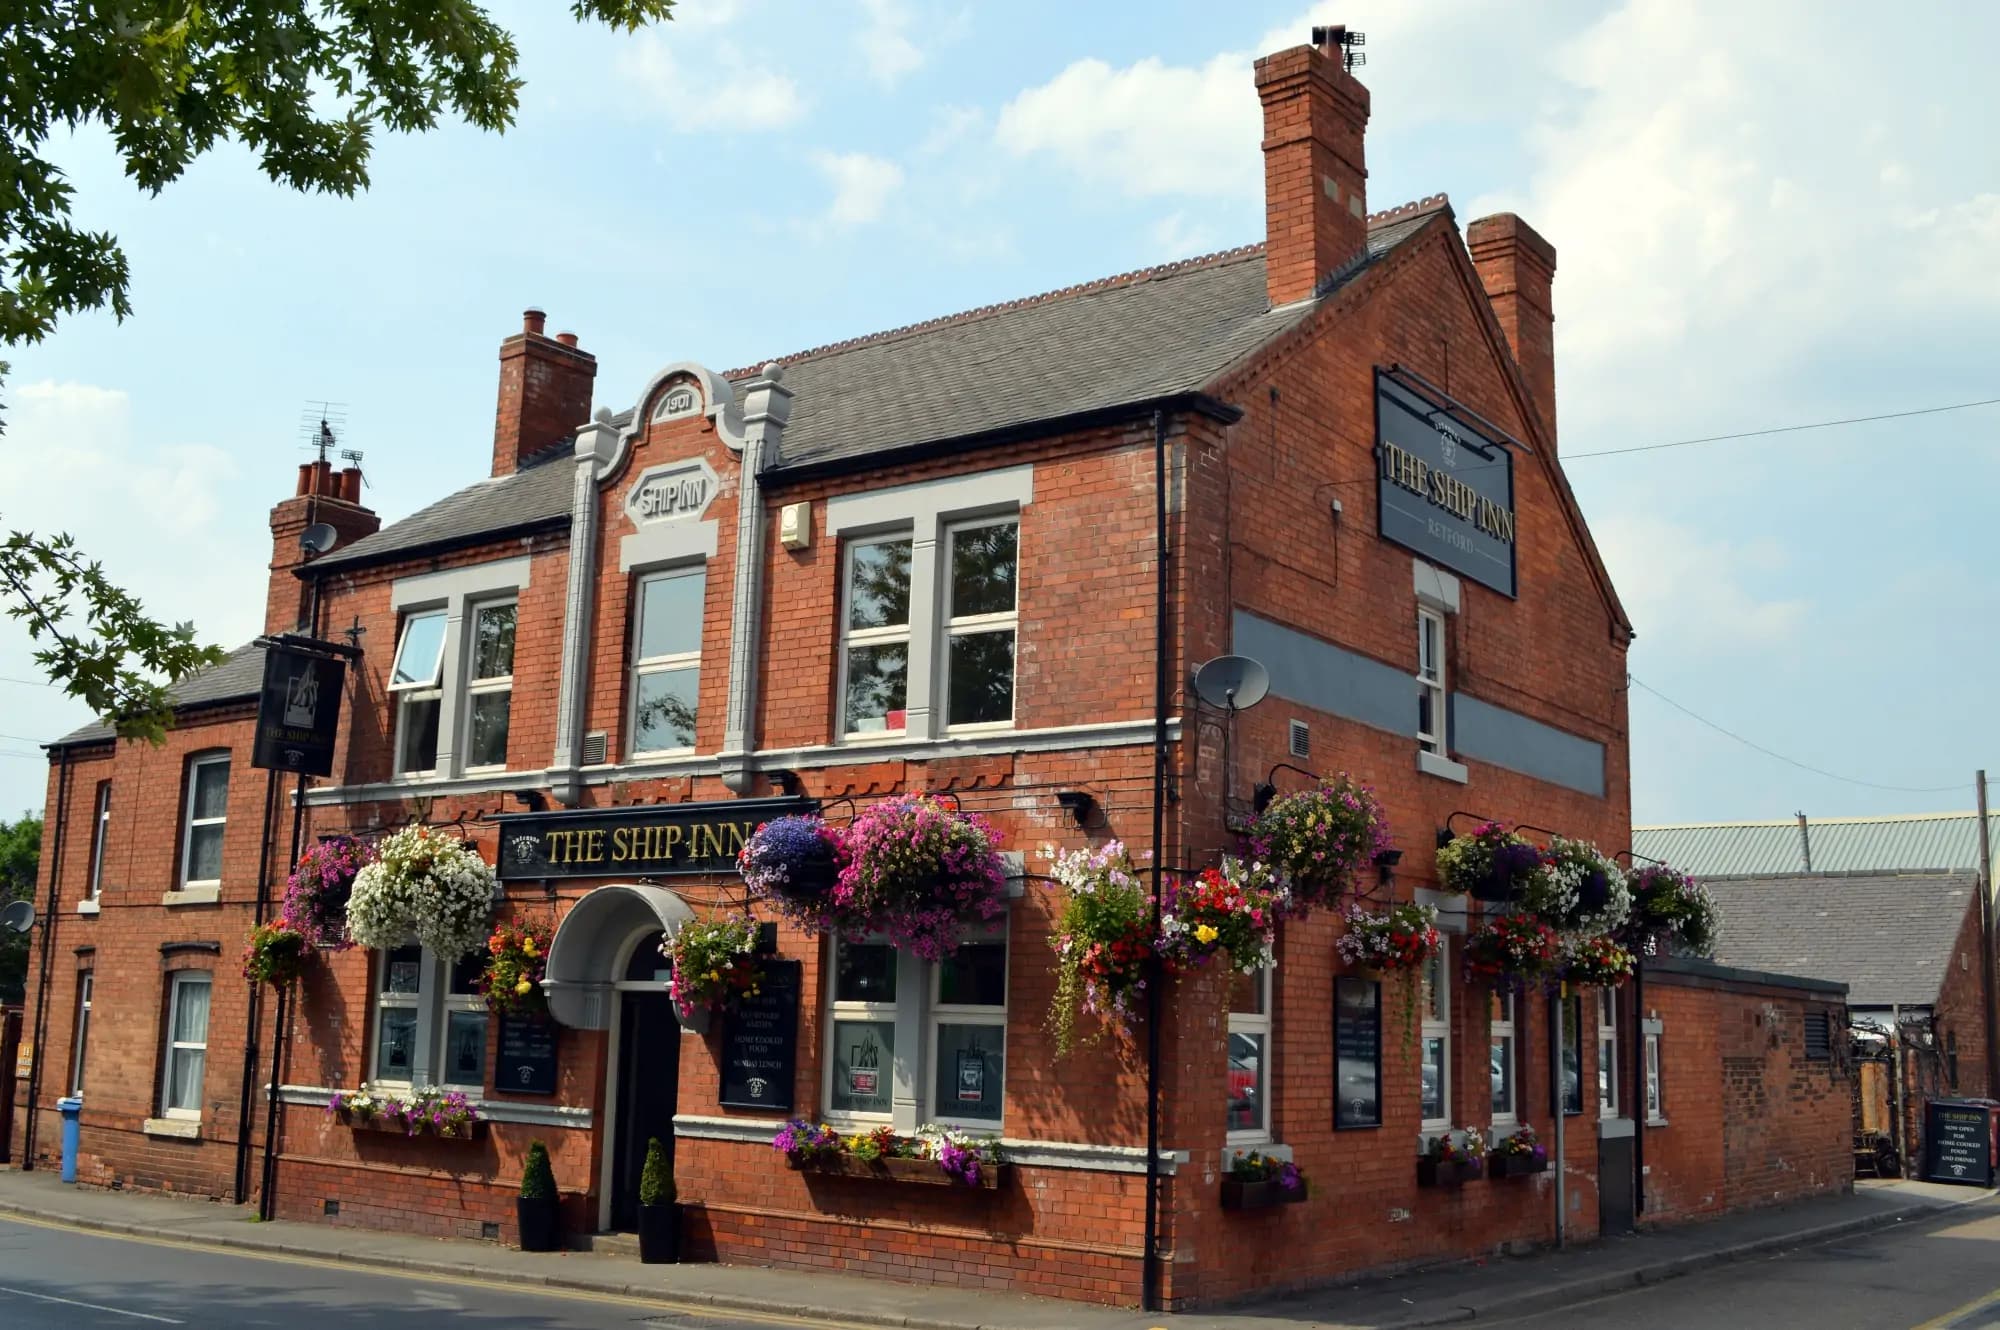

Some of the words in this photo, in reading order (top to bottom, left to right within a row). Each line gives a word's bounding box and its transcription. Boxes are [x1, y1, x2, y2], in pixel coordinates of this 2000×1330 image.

[667, 394, 690, 410] 1901
[640, 485, 678, 515] SHIP
[678, 478, 706, 509] INN
[1385, 440, 1429, 497] THE
[1434, 469, 1476, 521] SHIP
[1480, 496, 1514, 544] INN
[1427, 517, 1475, 554] RETFORD
[265, 727, 284, 738] THE
[546, 829, 606, 863] THE
[612, 825, 681, 861] SHIP
[688, 822, 752, 858] INN
[1956, 1141, 1981, 1149] COOKED
